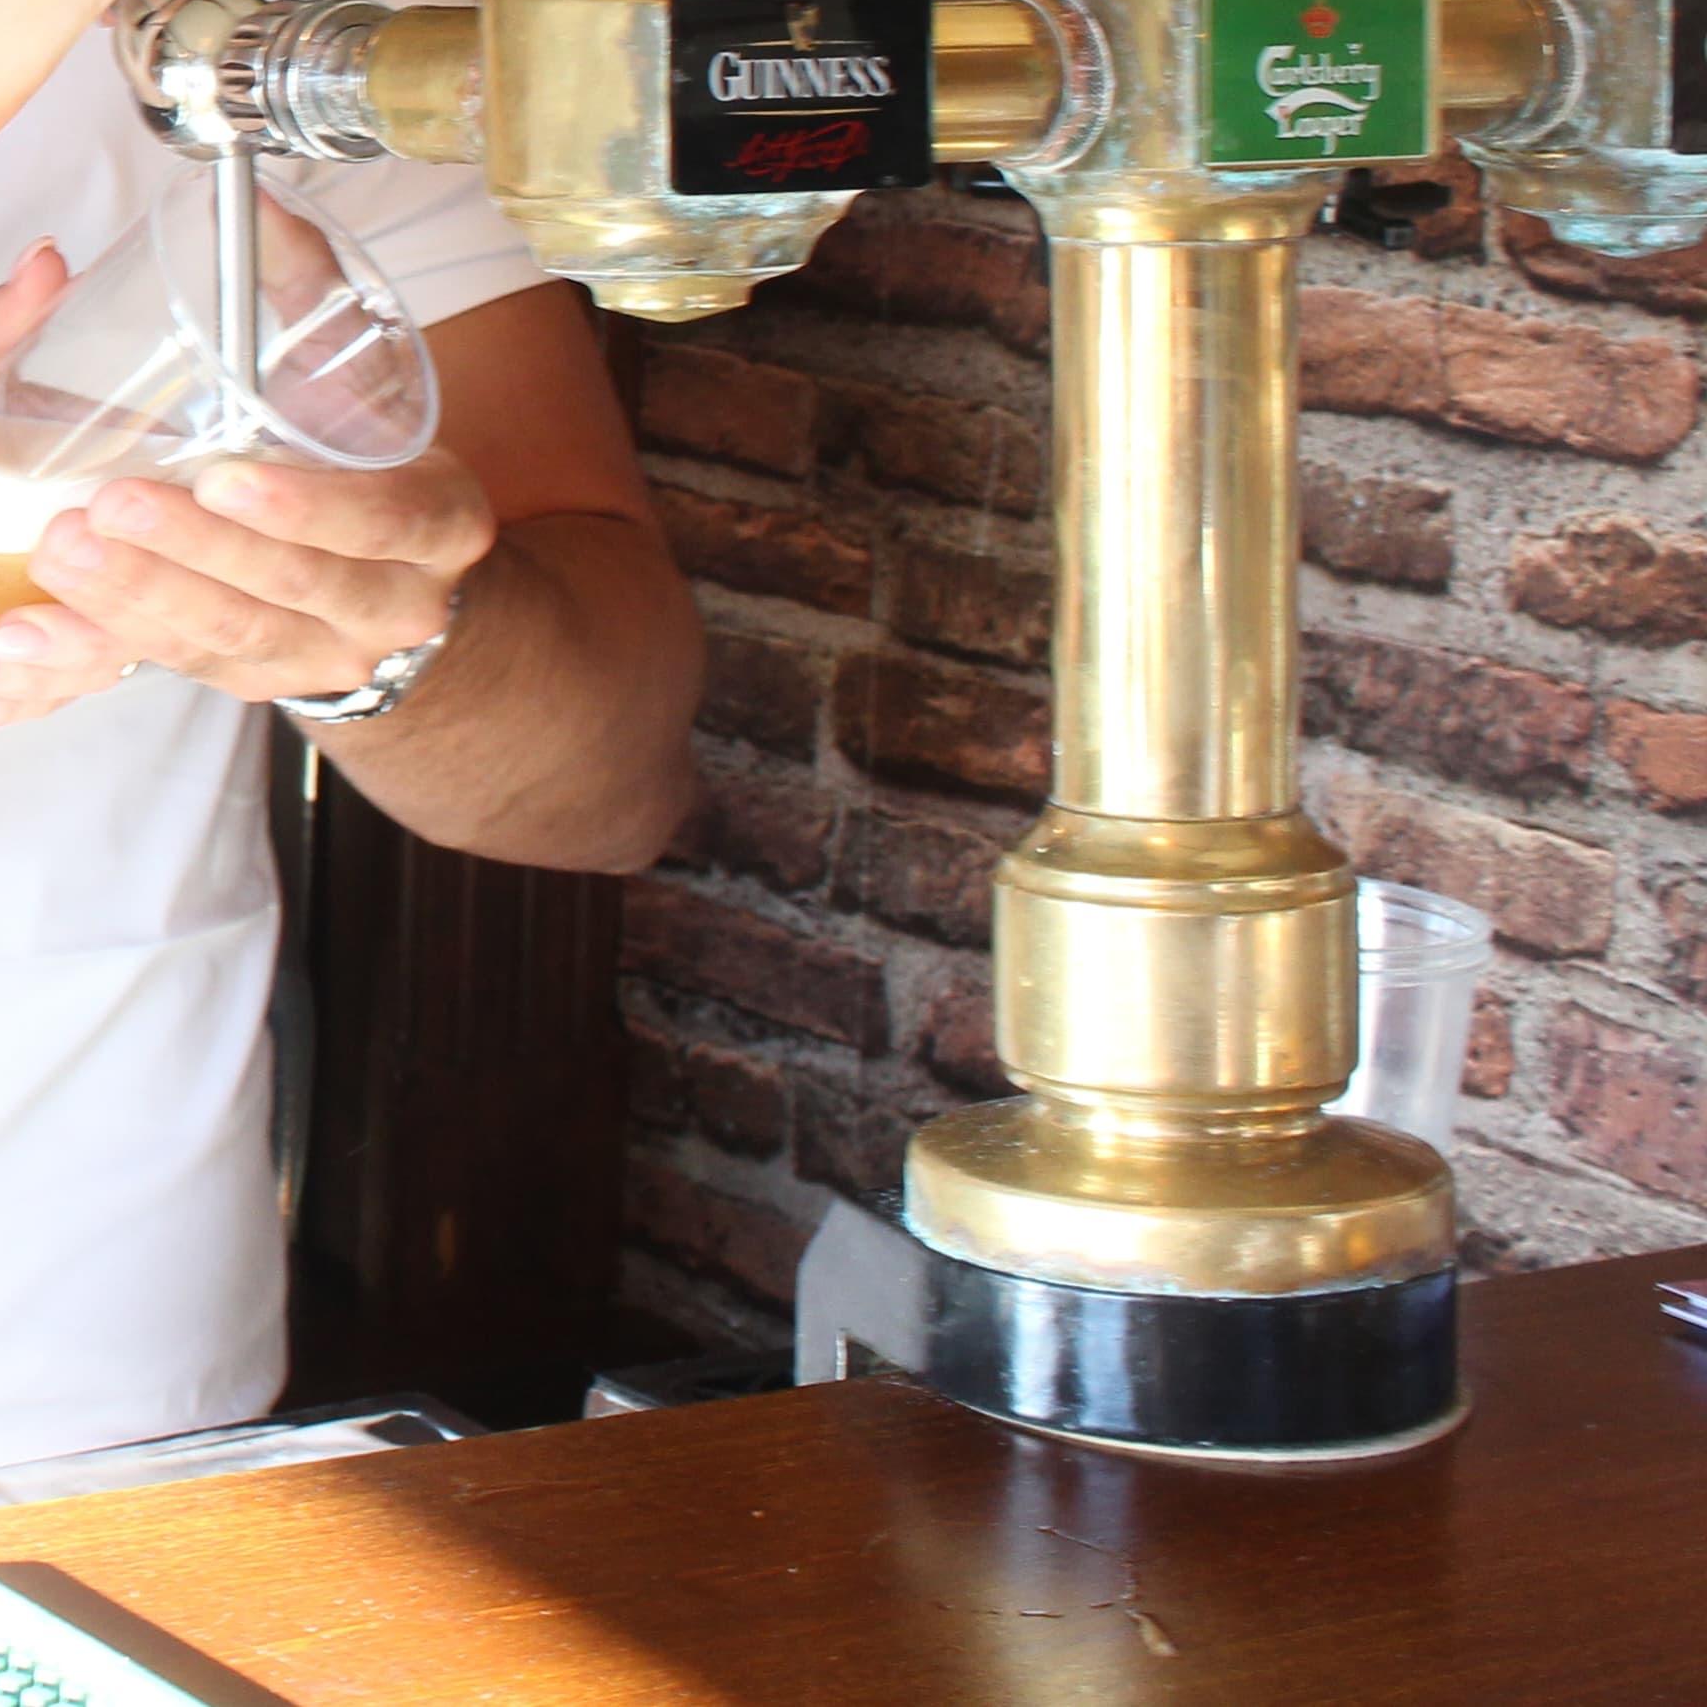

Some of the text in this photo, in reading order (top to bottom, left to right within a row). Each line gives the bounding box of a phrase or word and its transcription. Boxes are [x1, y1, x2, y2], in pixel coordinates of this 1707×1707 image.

[707, 51, 893, 102] GUINNESS
[1255, 43, 1382, 101] Carlsberg
[1271, 100, 1368, 156] Lager
